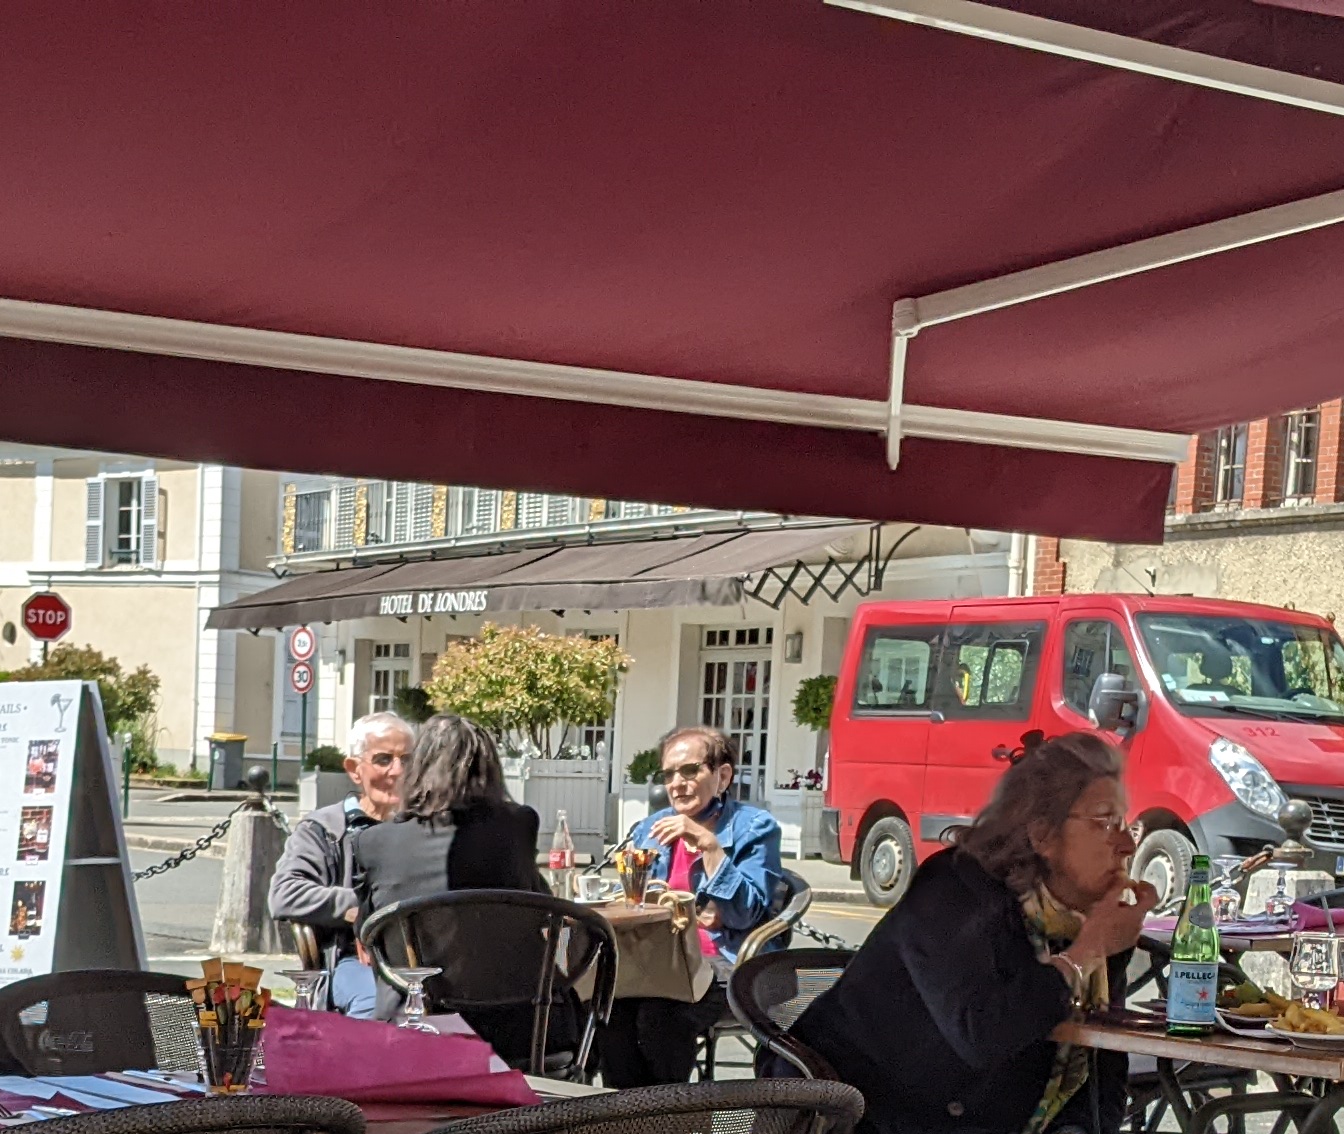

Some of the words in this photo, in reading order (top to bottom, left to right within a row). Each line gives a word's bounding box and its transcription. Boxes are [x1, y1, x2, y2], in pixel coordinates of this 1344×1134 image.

[379, 593, 414, 615] HOTEL
[417, 592, 434, 613] DE
[434, 590, 488, 612] LONDRES
[26, 608, 66, 625] STOP
[296, 670, 309, 683] 30
[1242, 726, 1280, 737] 312
